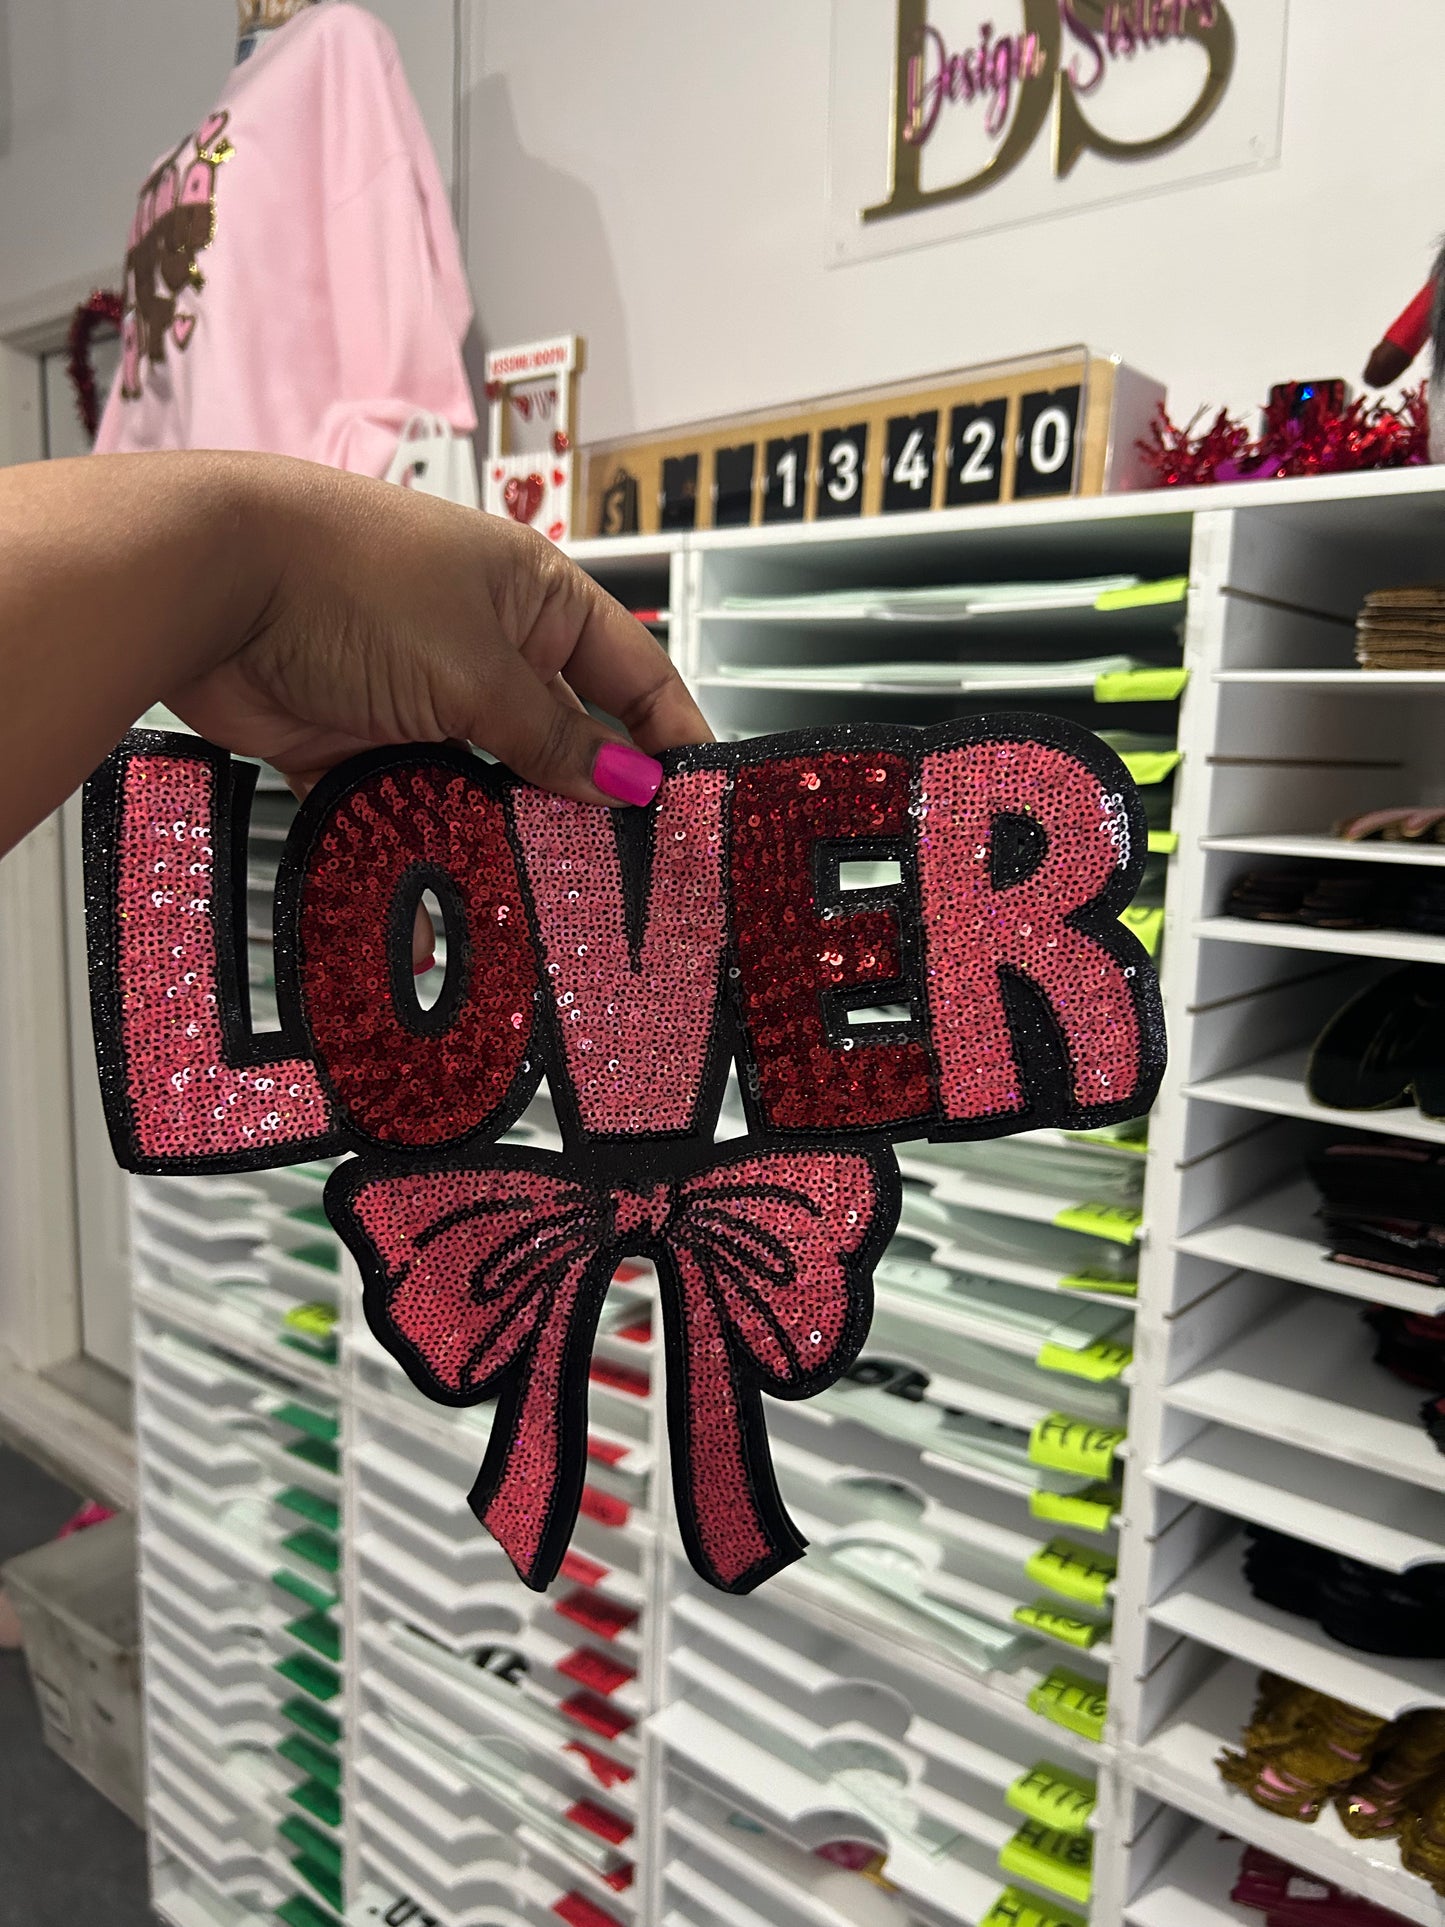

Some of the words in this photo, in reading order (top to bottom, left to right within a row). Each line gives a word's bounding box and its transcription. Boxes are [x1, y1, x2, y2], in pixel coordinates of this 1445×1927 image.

[902, 22, 1047, 146] Design
[776, 405, 1072, 508] 13420
[112, 734, 1148, 1158] LOVER
